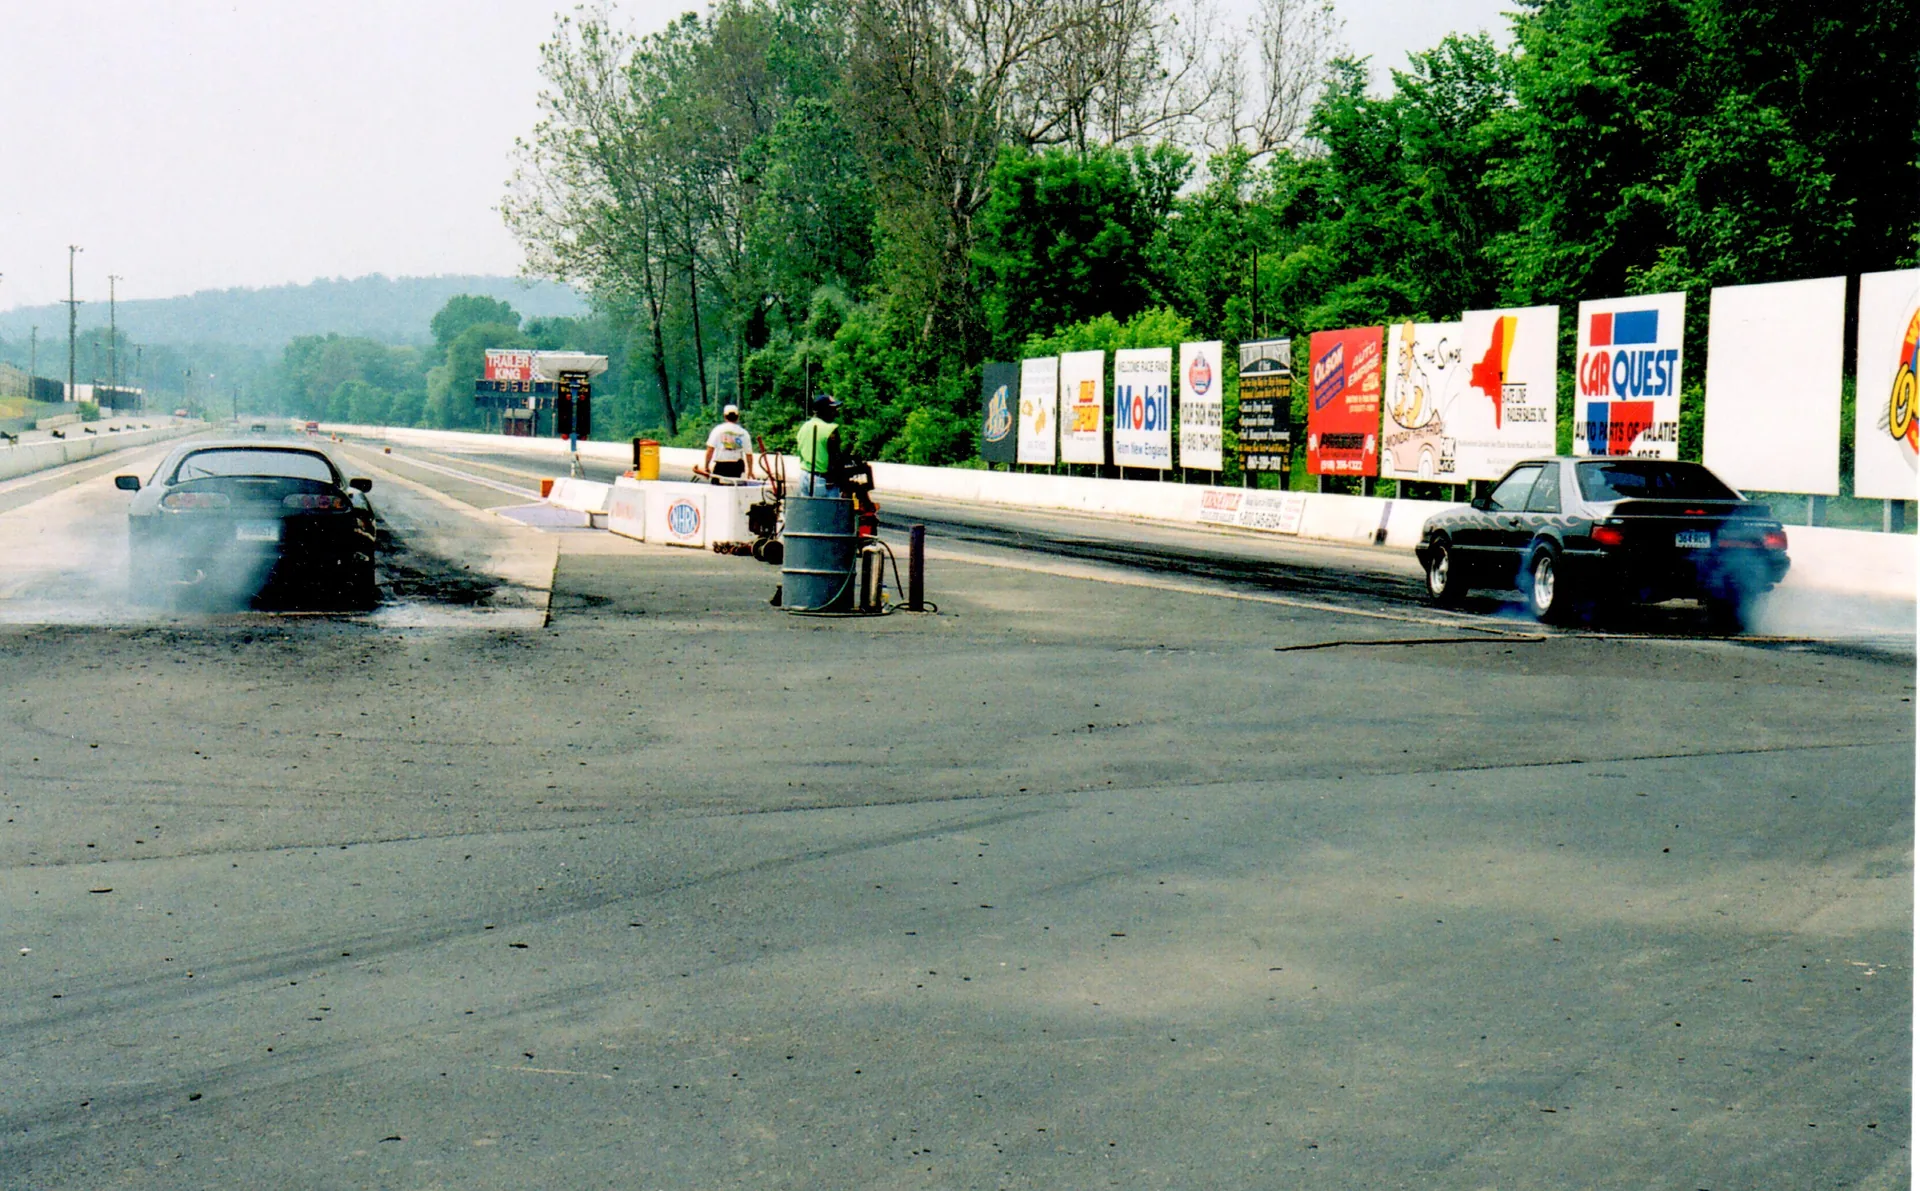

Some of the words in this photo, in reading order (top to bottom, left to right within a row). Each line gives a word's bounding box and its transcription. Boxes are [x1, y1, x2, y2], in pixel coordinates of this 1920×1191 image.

[487, 355, 530, 368] TRAILER
[1352, 341, 1377, 369] AUTO
[494, 367, 521, 380] KING
[1141, 360, 1154, 373] RACE
[1155, 360, 1168, 373] FANS
[1314, 345, 1344, 386] OLSON
[1116, 384, 1168, 431] Mobil
[1385, 431, 1410, 447] MONDAY
[1575, 421, 1597, 441] AUTO
[1599, 421, 1624, 442] PARTS
[1626, 421, 1639, 442] OF
[1642, 421, 1677, 442] VALATIE
[1144, 441, 1168, 459] England
[671, 504, 698, 534] NHRA
